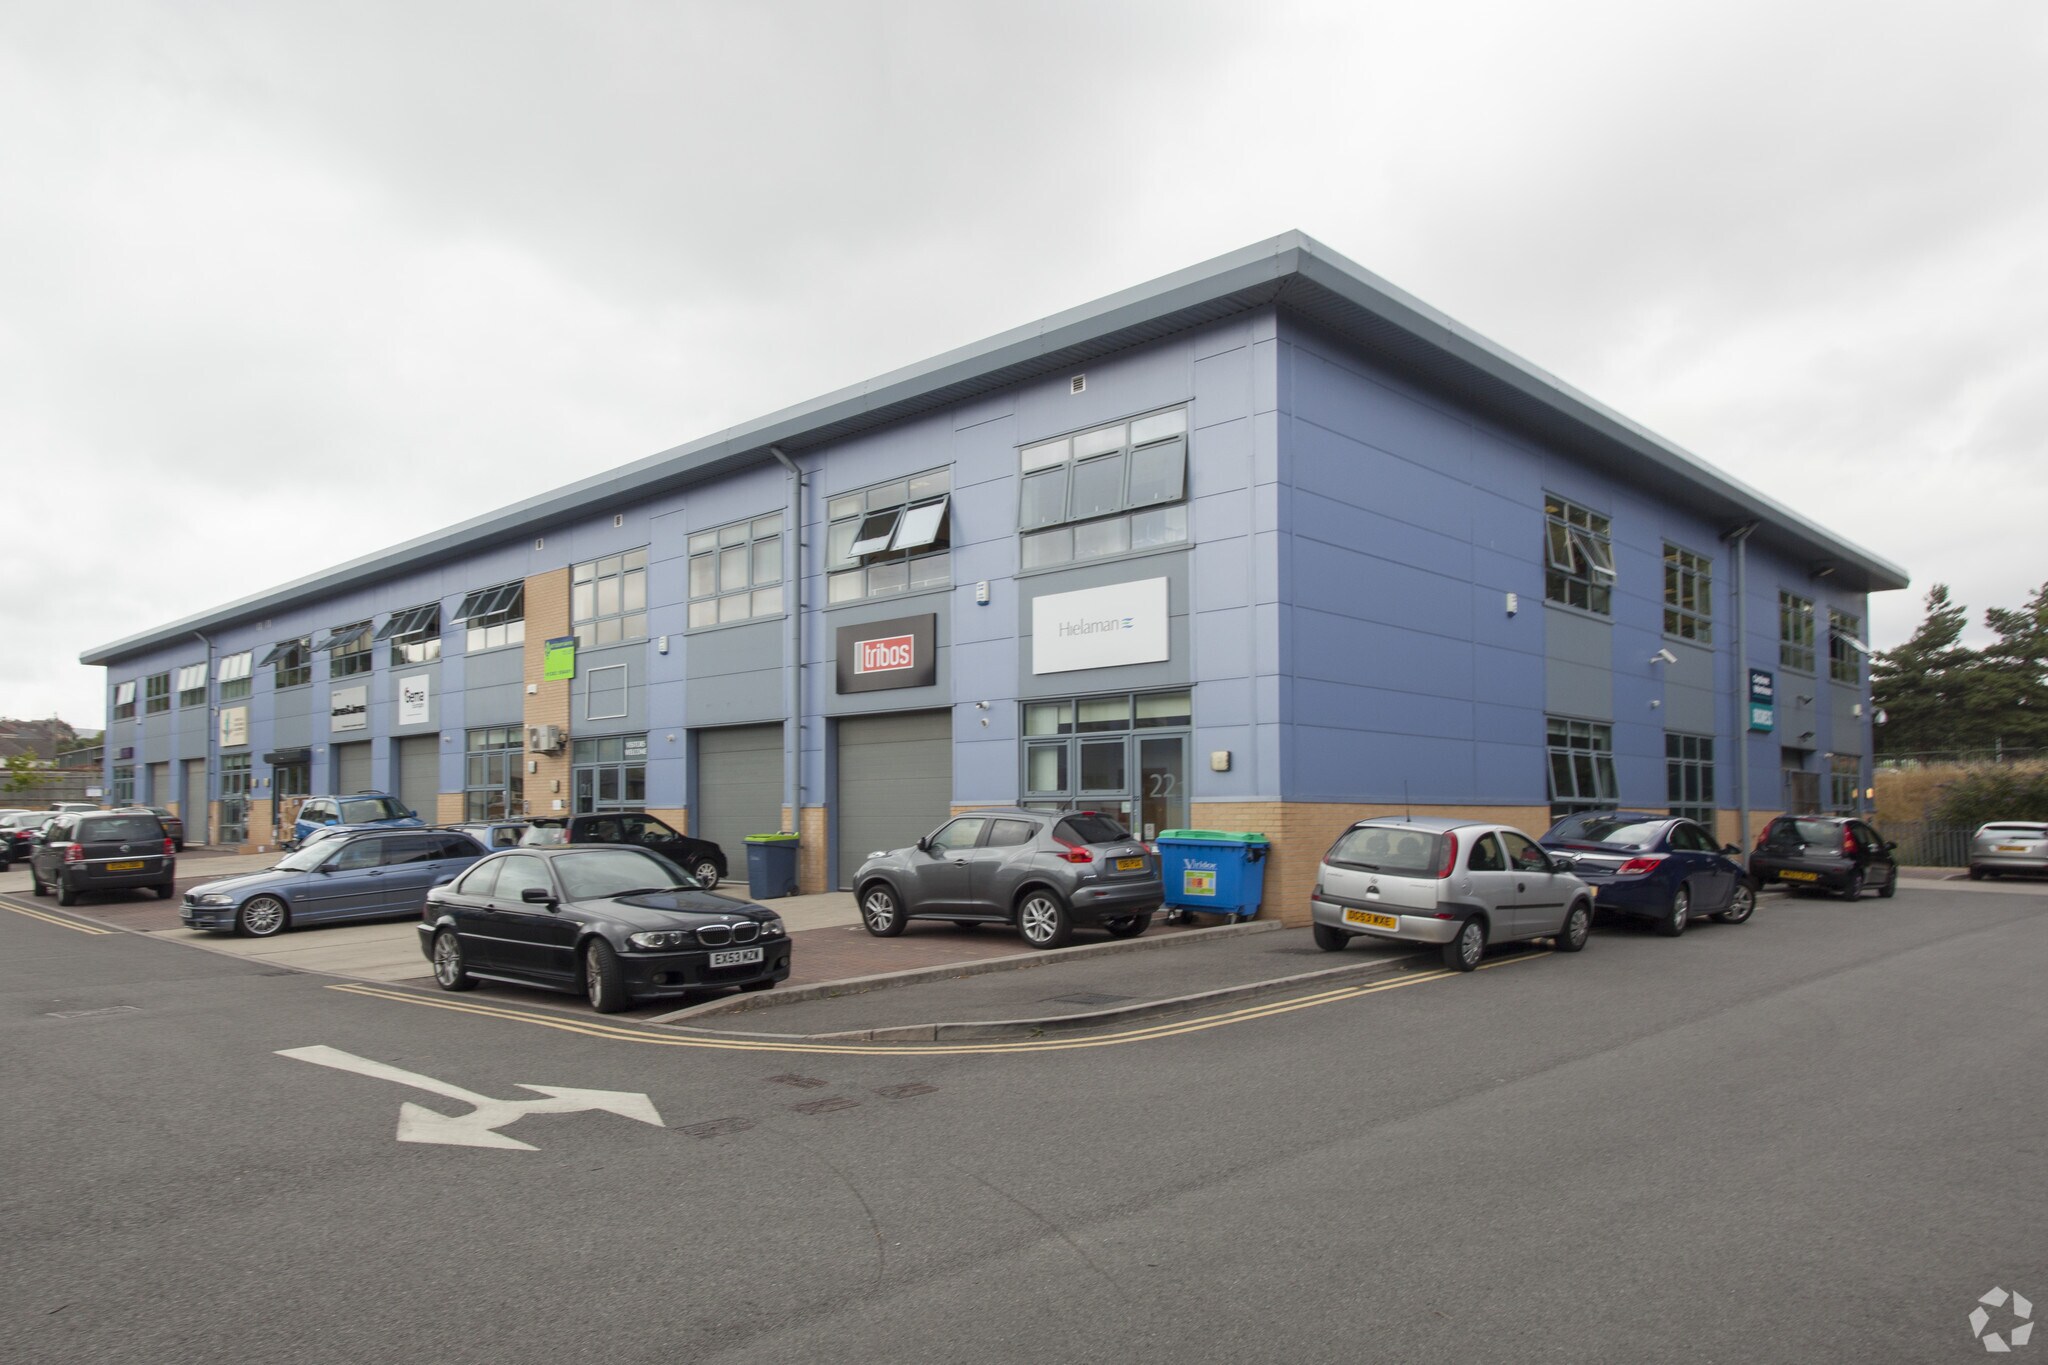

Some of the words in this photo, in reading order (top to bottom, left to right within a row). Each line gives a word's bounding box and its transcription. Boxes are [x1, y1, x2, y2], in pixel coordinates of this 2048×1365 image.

[1058, 618, 1119, 637] Hielaman
[865, 643, 910, 668] tribos
[1149, 773, 1176, 797] 22
[715, 952, 740, 965] EX53
